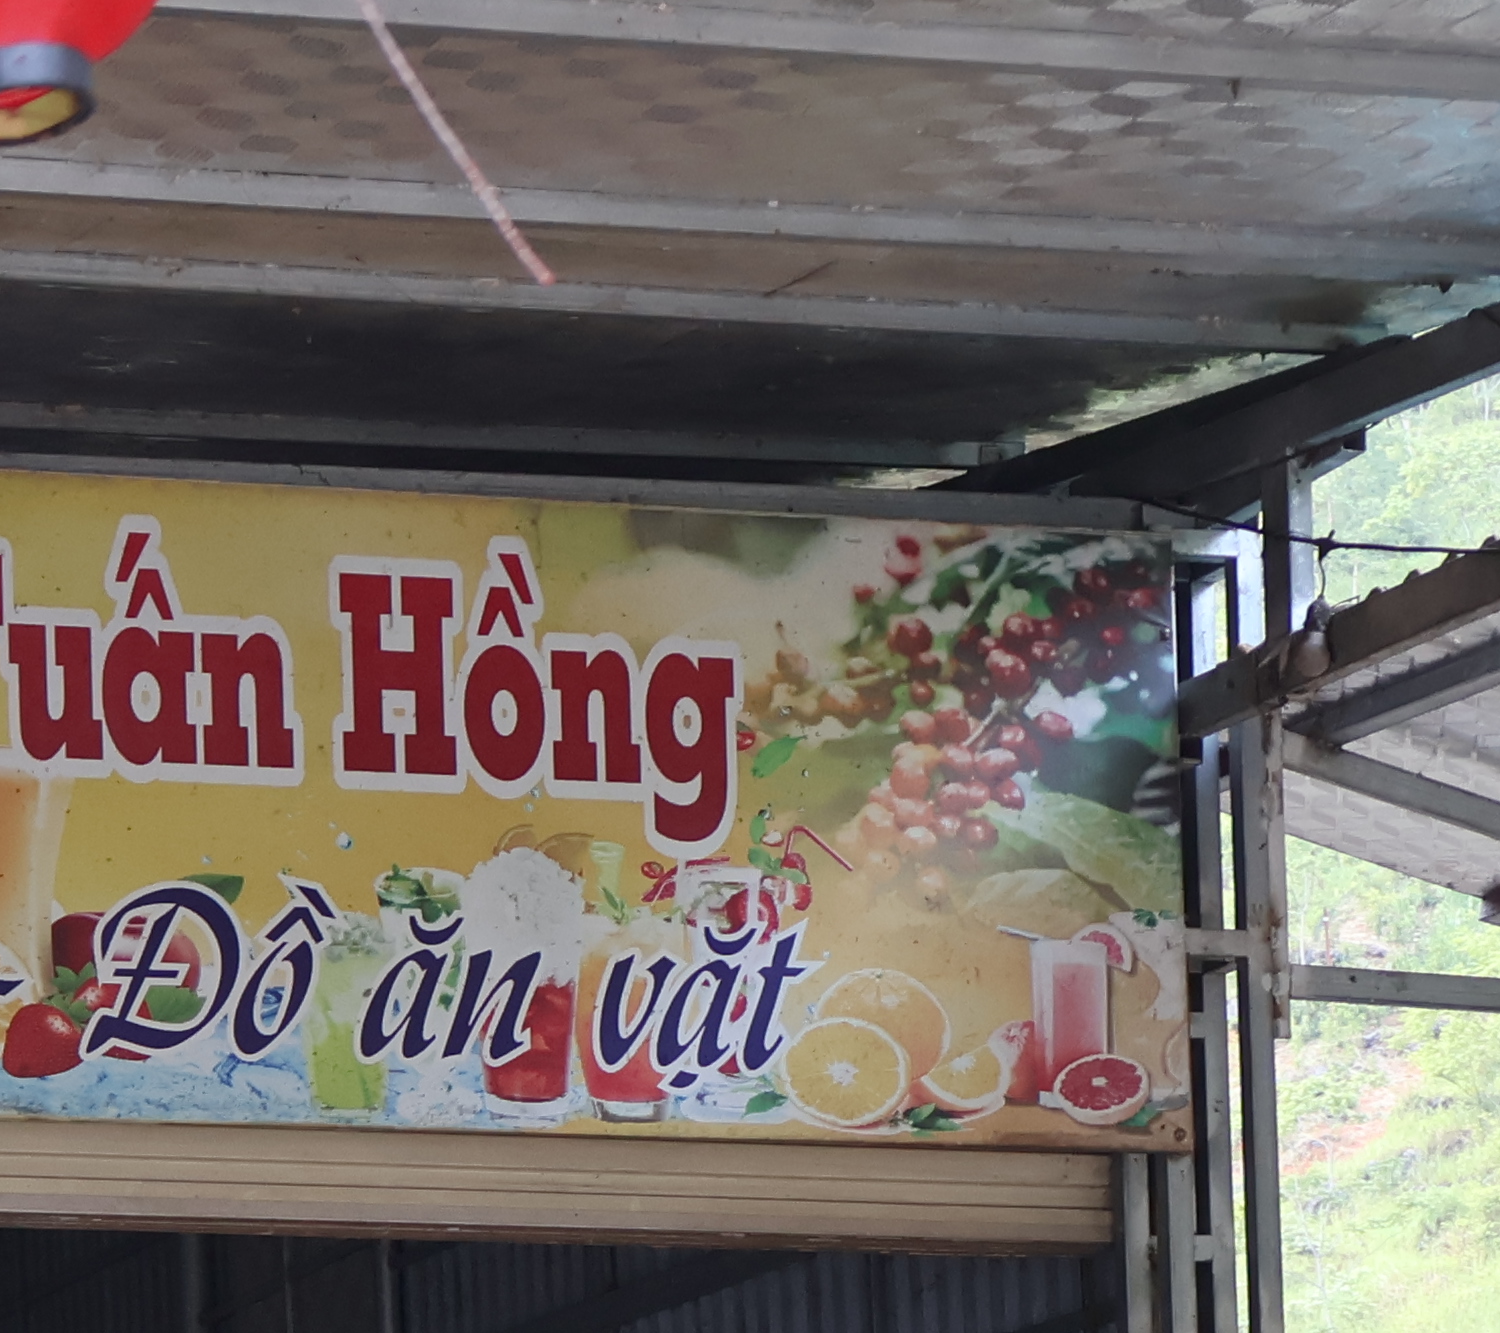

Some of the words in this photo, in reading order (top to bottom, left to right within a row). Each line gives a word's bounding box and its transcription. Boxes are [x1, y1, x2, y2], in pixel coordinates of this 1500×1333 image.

[339, 541, 736, 843] Hồng
[85, 874, 331, 1058] Đồ
[363, 930, 539, 1068] ăn
[595, 920, 806, 1085] vặt
